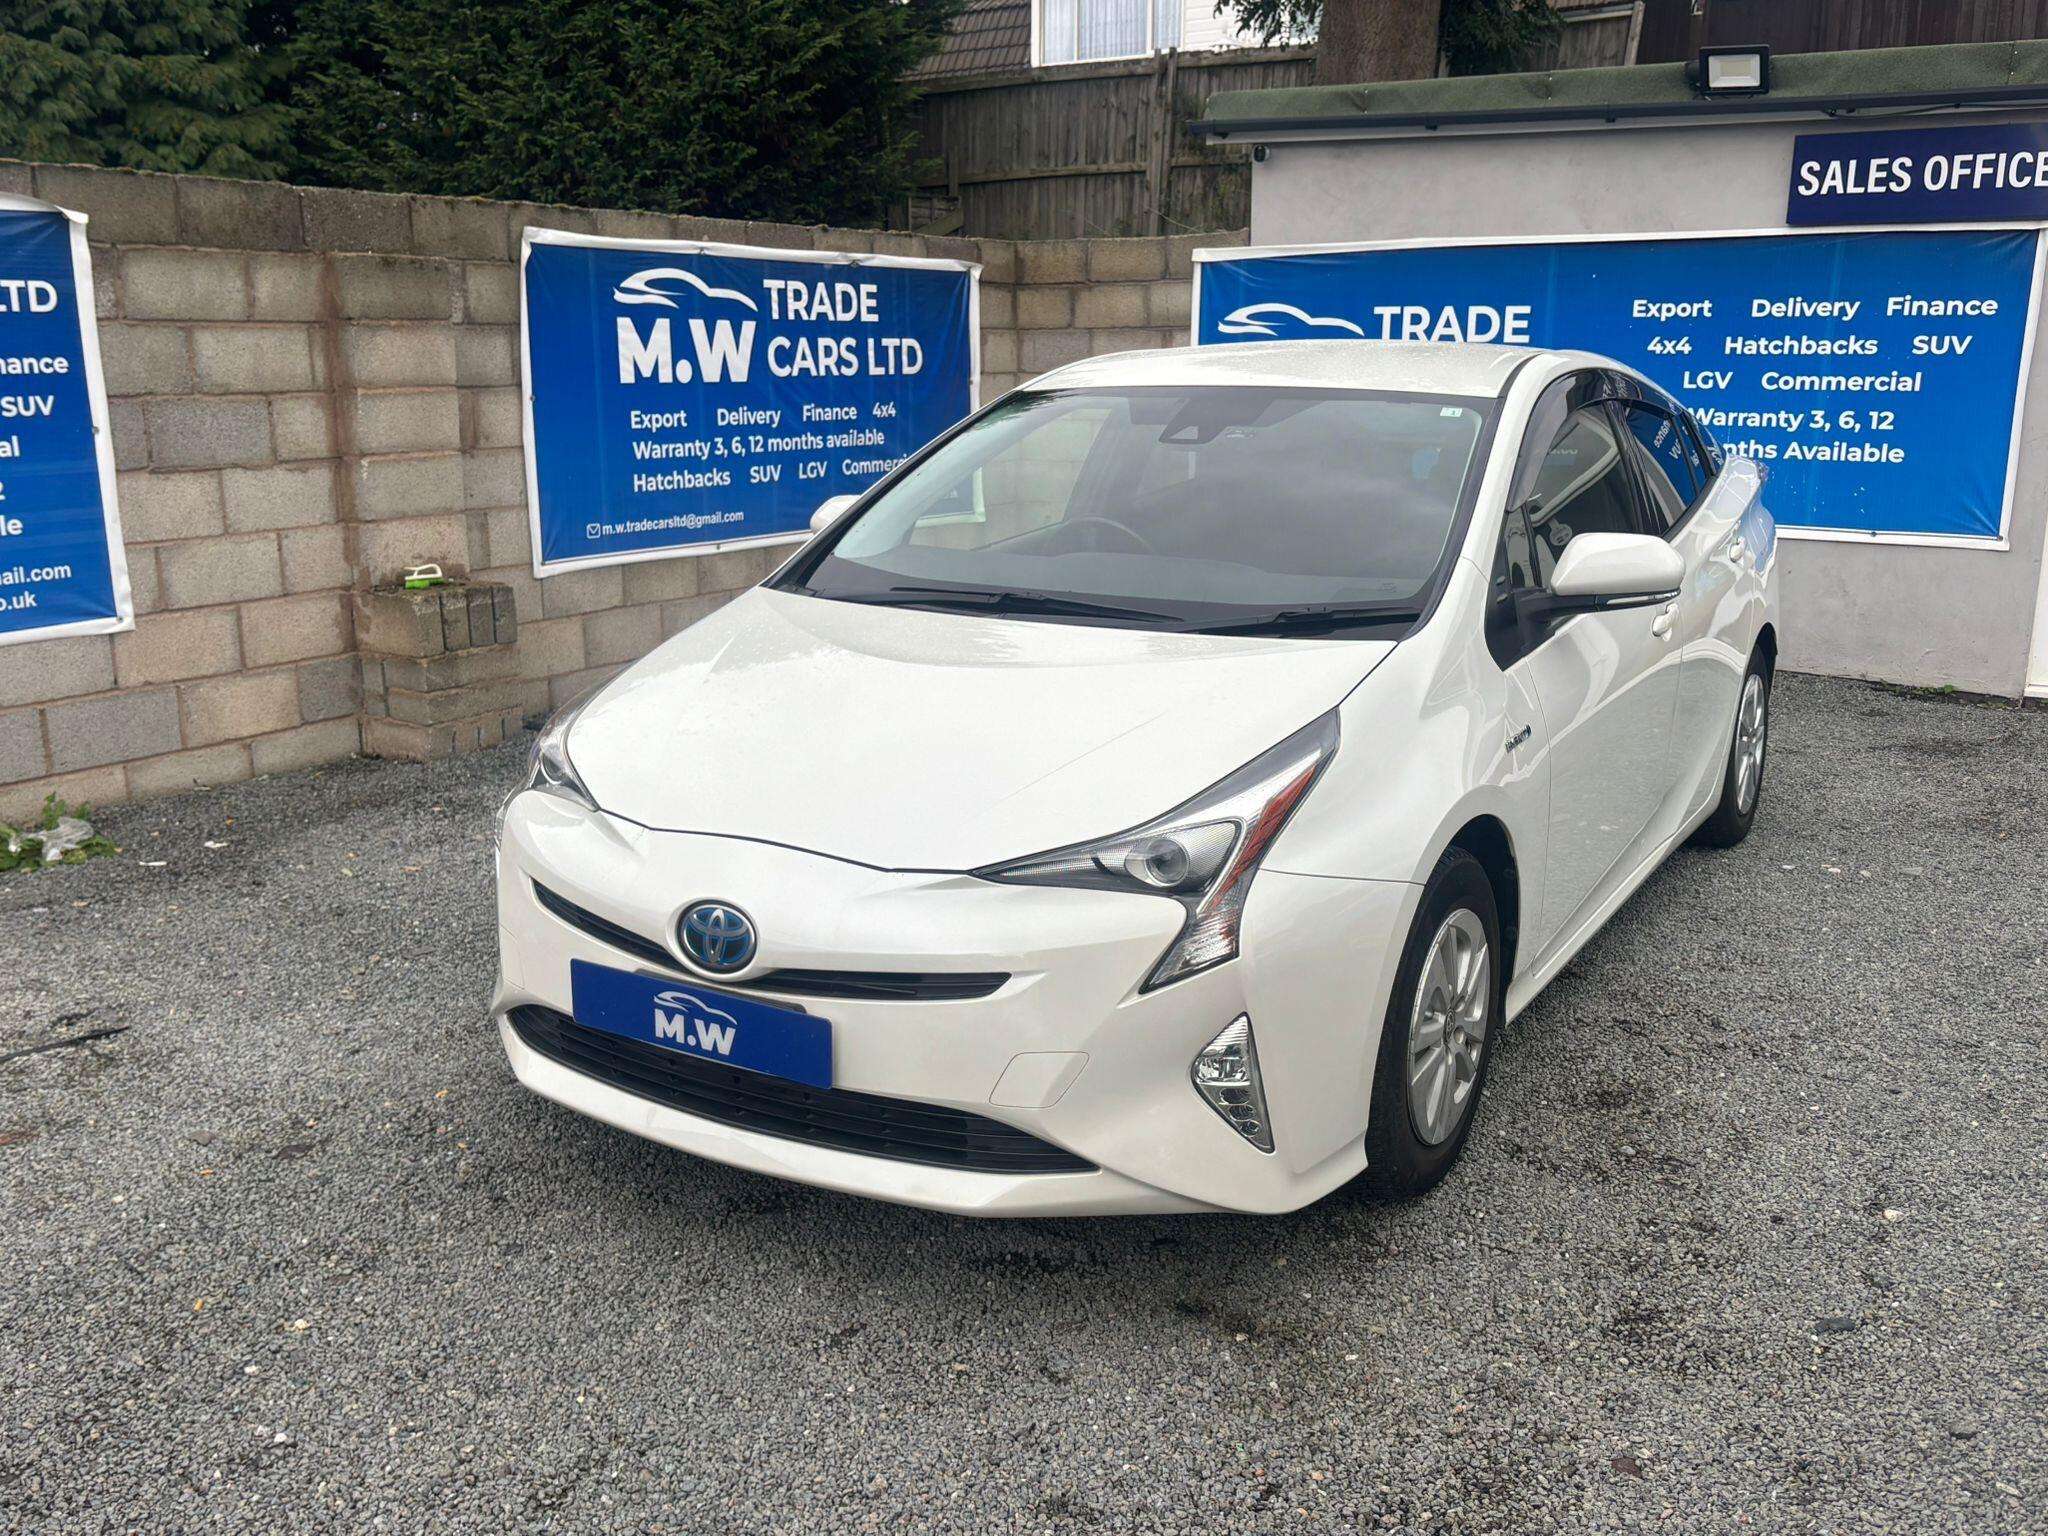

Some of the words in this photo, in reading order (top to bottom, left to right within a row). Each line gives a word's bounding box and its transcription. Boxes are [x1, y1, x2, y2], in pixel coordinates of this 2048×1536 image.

[1797, 157, 1913, 196] SALES
[1923, 150, 2048, 191] OFFICE
[763, 280, 880, 323] TRADE
[1632, 299, 1712, 321] Export
[1751, 297, 1861, 321] Delivery
[1886, 296, 1998, 316] Finance
[1373, 305, 1531, 343] TRADE
[617, 317, 757, 384] M.W
[768, 338, 858, 378] CARS
[868, 340, 923, 376] LTD
[1647, 337, 1692, 354] 4x4
[1725, 336, 1878, 355] Hatchbacks
[1912, 335, 1972, 355] SUV
[1683, 371, 1733, 390] LGV
[1761, 371, 1922, 392] Commercial
[1, 395, 54, 417] SUV
[631, 411, 687, 430] Export
[717, 408, 781, 427] Delivery
[803, 405, 857, 422] Finance
[872, 403, 896, 417] 4x4
[1688, 407, 1804, 432] Warranty
[1809, 410, 1831, 431] 3,
[1838, 411, 1861, 431] 6,
[1869, 411, 1895, 430] 12
[633, 441, 710, 461] Warranty
[714, 438, 728, 457] 3,
[732, 437, 746, 455] 6,
[749, 436, 764, 453] 12
[768, 435, 823, 450] months
[826, 429, 885, 449] available
[1783, 441, 1905, 464] Available
[633, 472, 731, 493] Hatchbacks
[750, 465, 781, 483] SUV
[799, 461, 827, 480] LGV
[842, 453, 908, 476] Commer
[654, 1008, 737, 1056] M.W
